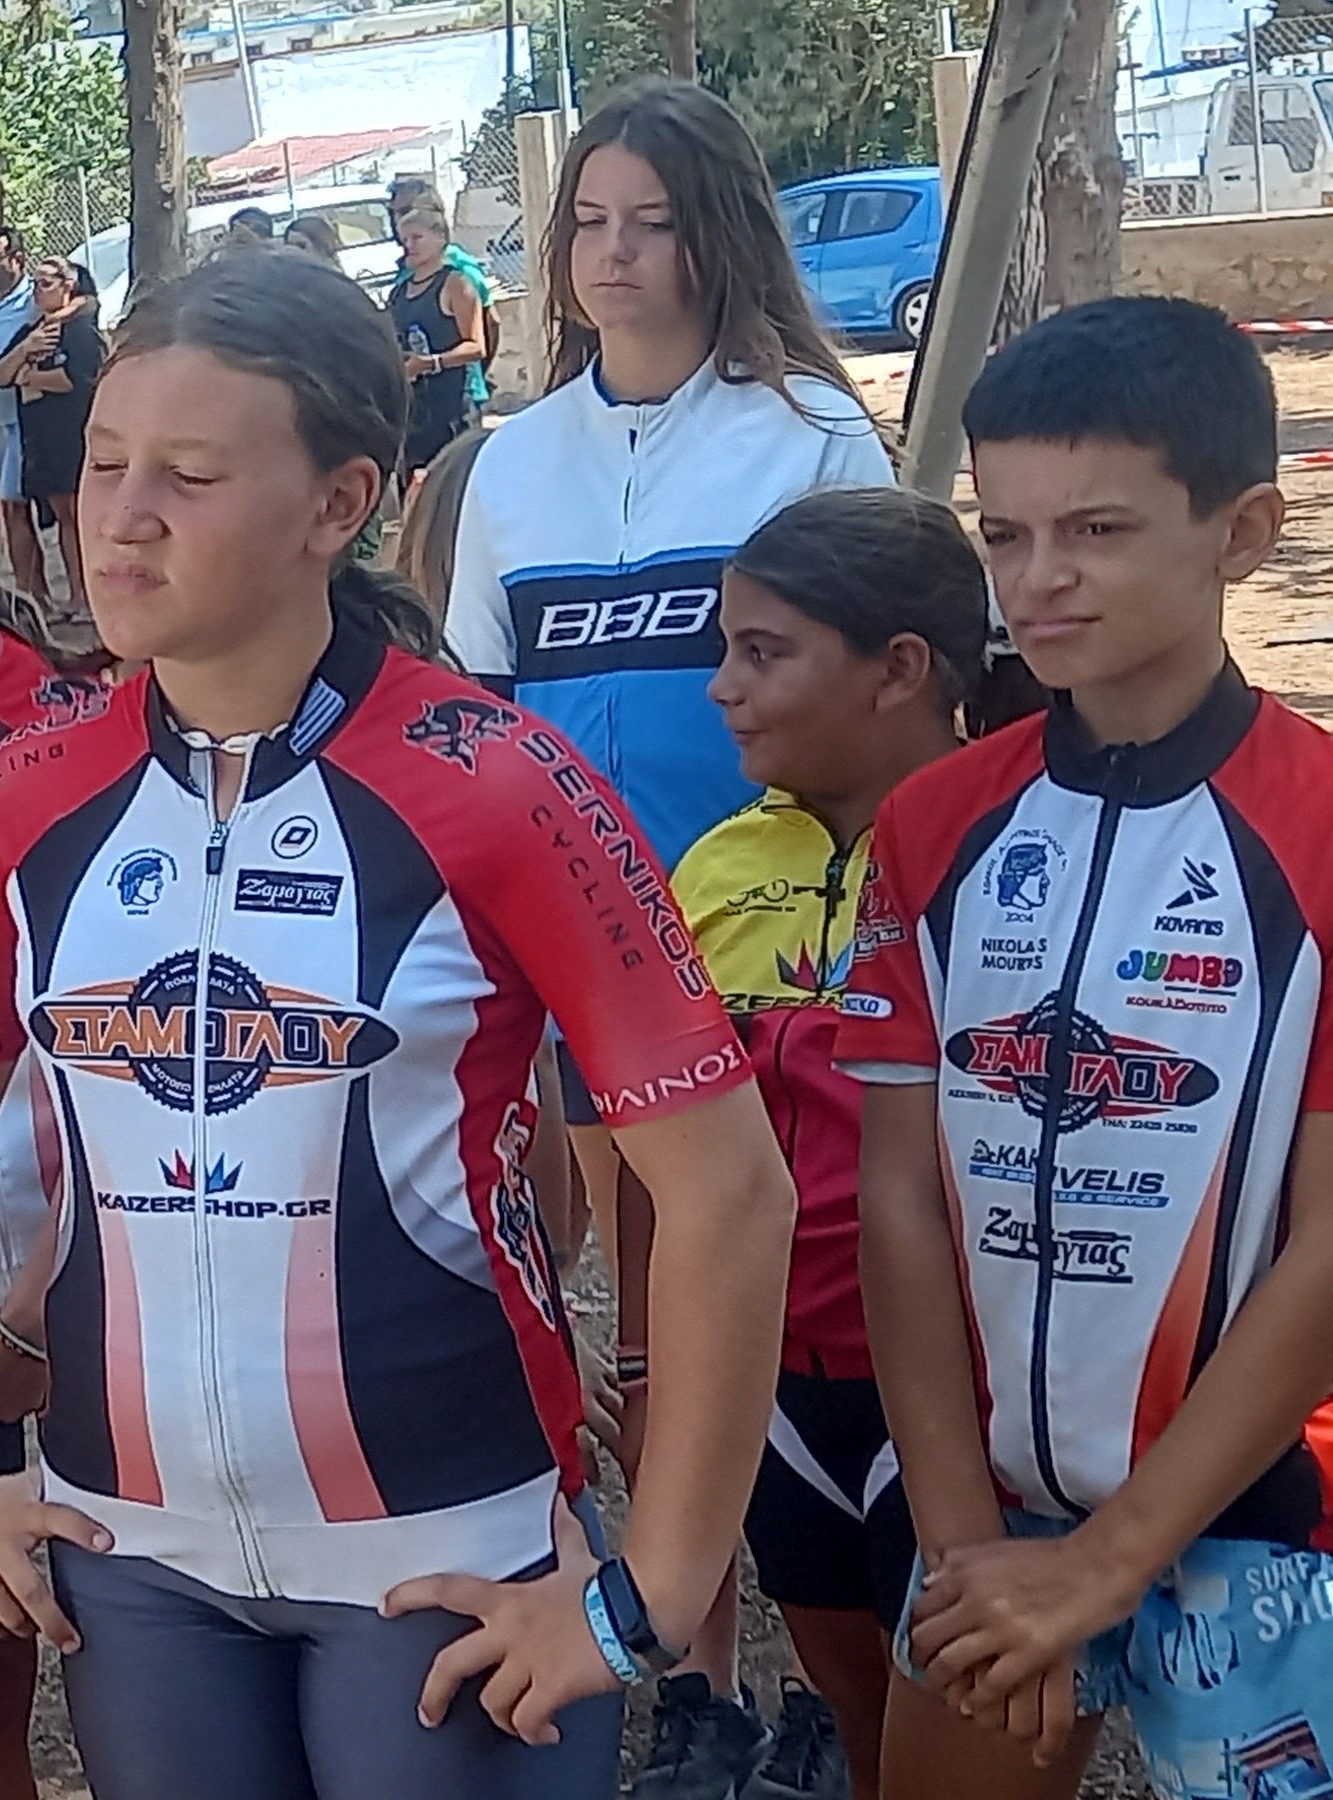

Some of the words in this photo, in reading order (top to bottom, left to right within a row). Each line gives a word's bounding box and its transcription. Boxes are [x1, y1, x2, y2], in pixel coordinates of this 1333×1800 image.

[535, 587, 719, 650] BBB
[518, 731, 711, 999] SERNIKOS
[530, 804, 644, 971] CYCLING
[981, 938, 1048, 955] NIKOLAS
[1116, 949, 1244, 989] JUMBO
[49, 1004, 366, 1068] ΣΤΑΜΟΓΛΟΥ
[97, 1191, 333, 1218] KAIZERSHOP.GR
